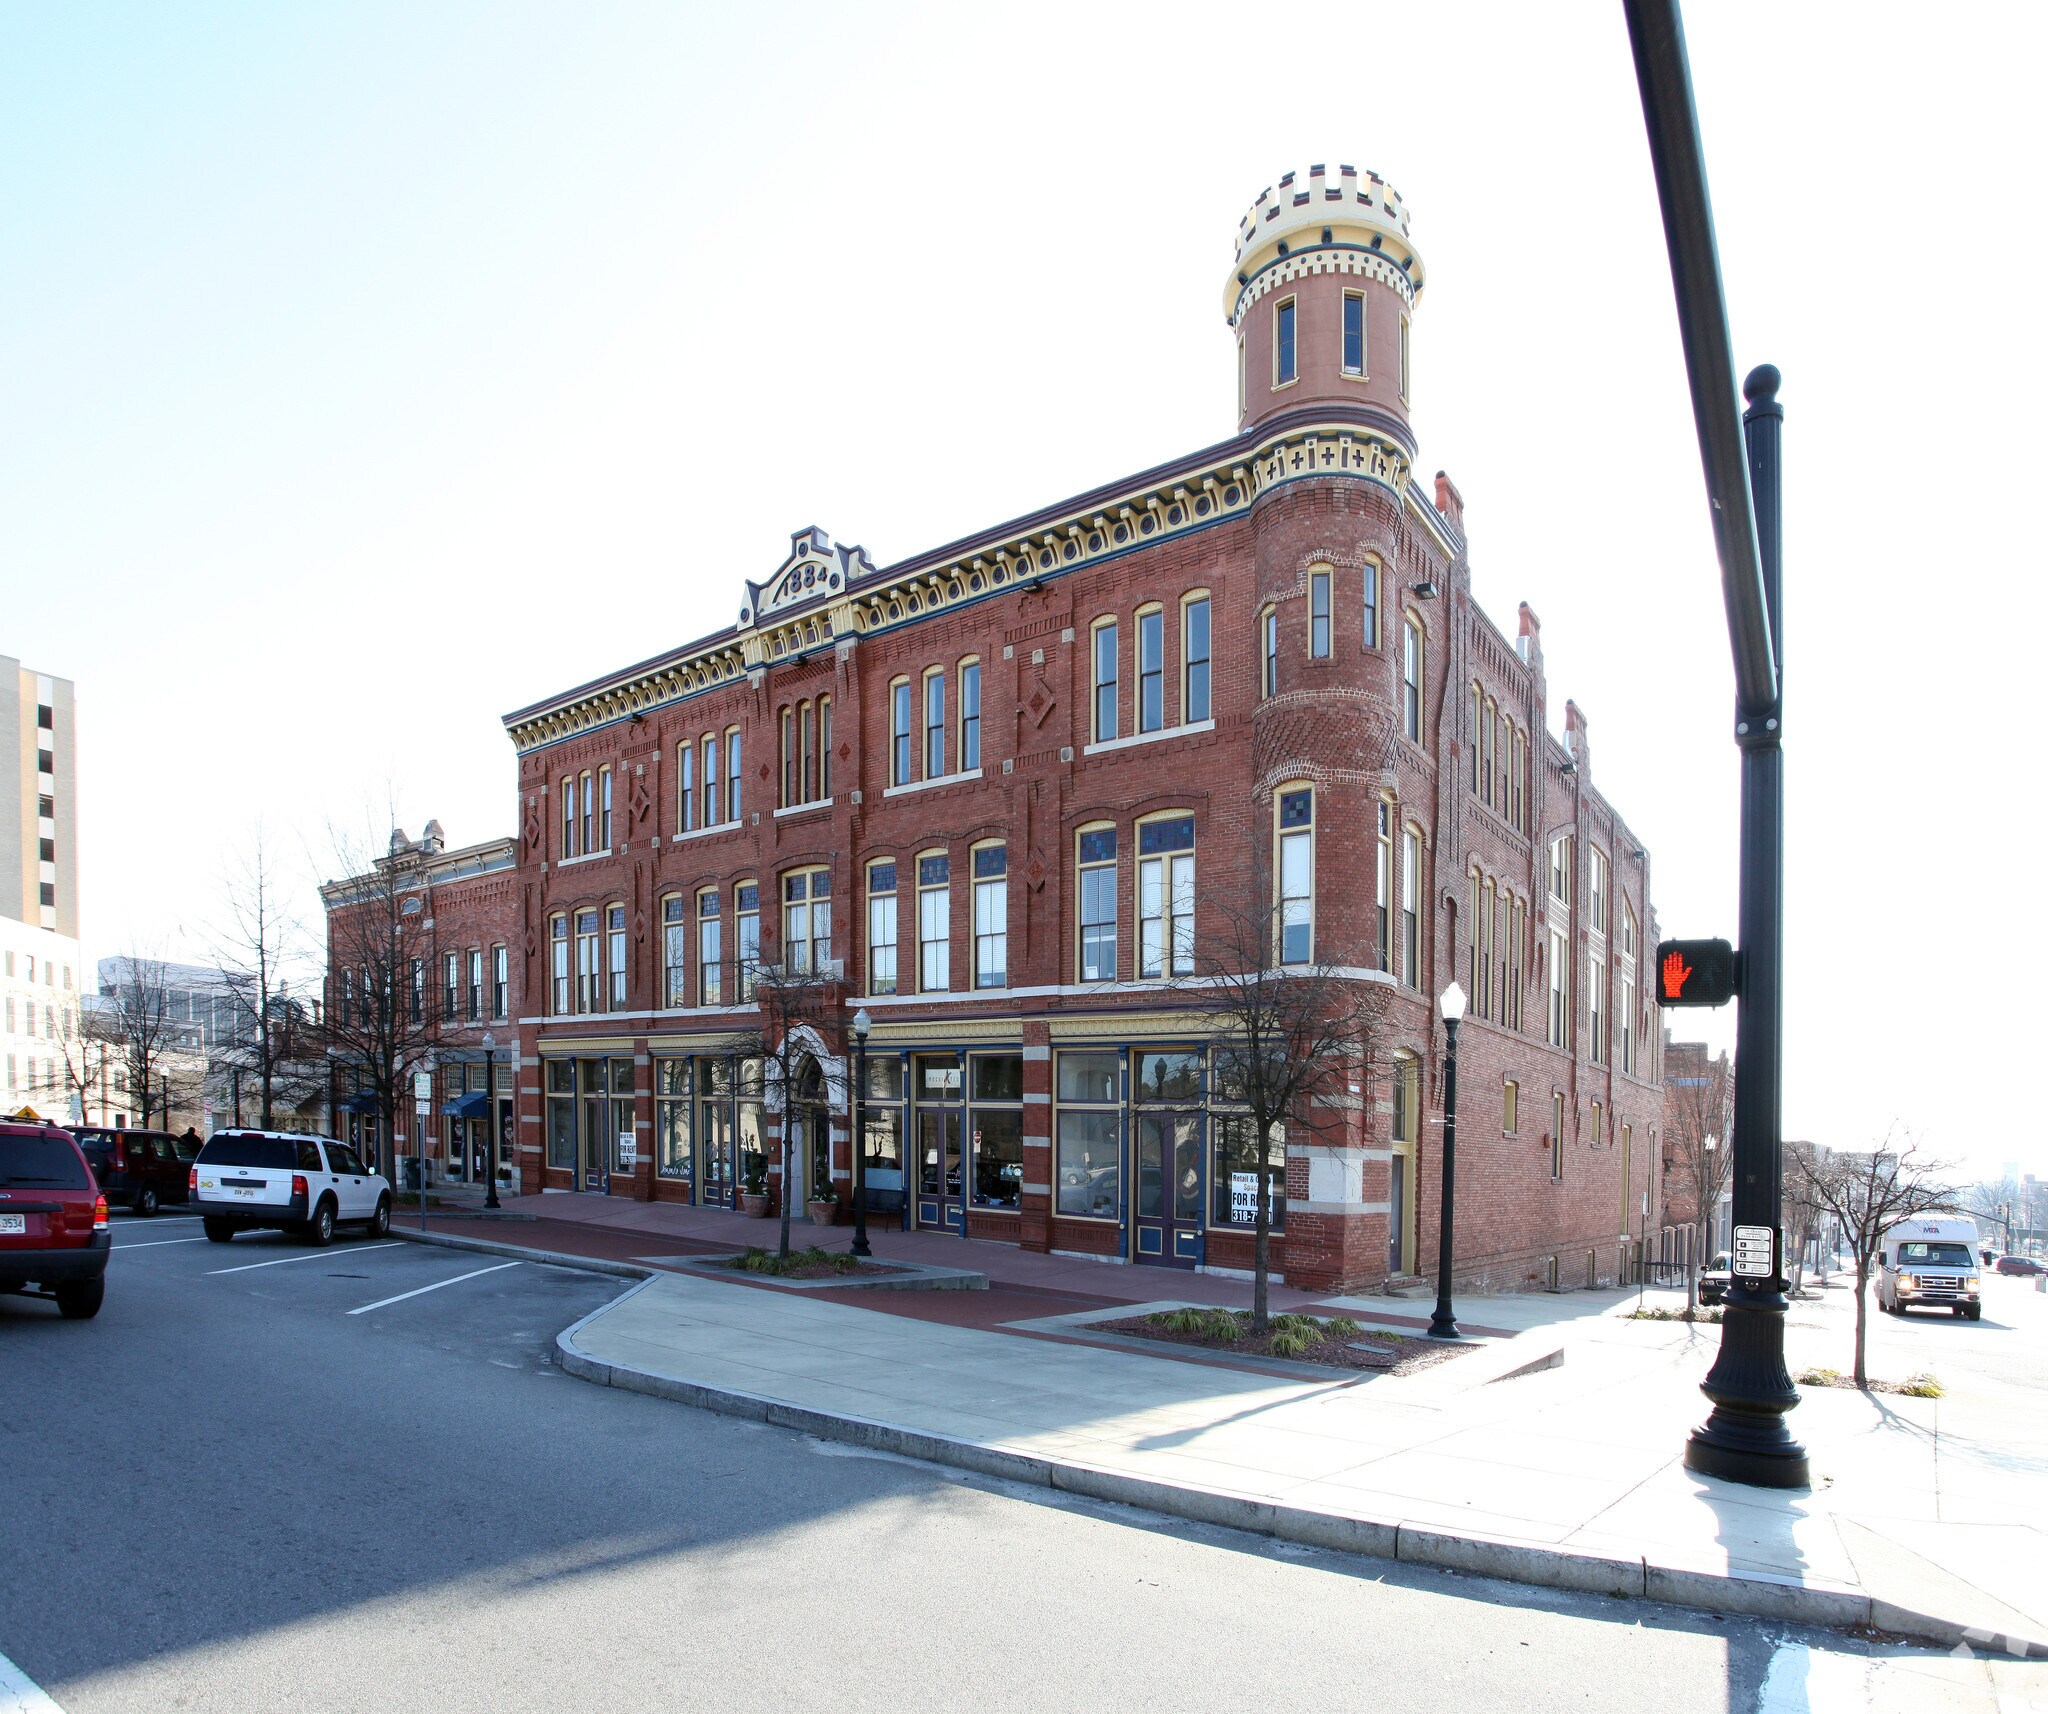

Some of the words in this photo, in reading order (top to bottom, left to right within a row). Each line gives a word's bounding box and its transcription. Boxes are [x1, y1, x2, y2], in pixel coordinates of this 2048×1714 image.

[783, 564, 828, 597] 1884
[1233, 1174, 1248, 1182] Retail
[1233, 1192, 1248, 1206] FOR
[1251, 1193, 1271, 1207] RT
